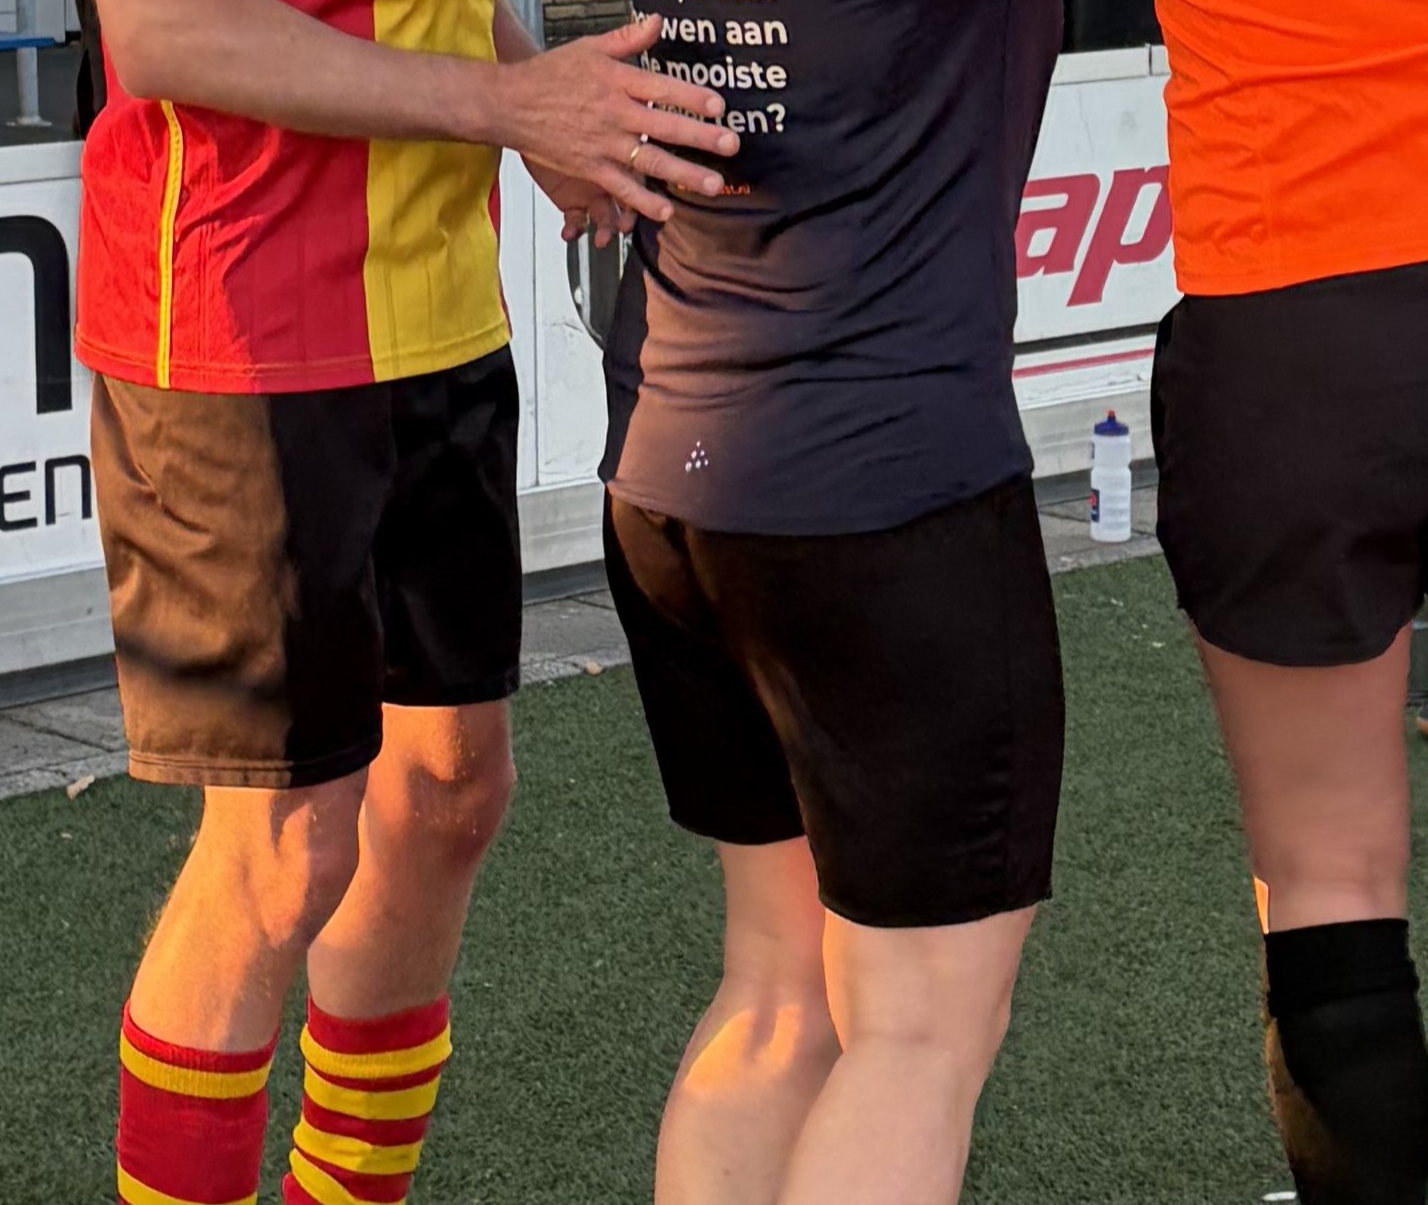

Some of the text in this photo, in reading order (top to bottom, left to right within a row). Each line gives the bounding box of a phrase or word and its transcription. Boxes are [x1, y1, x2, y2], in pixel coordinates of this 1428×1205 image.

[630, 1, 789, 45] wen aan
[666, 55, 788, 90] mooiste
